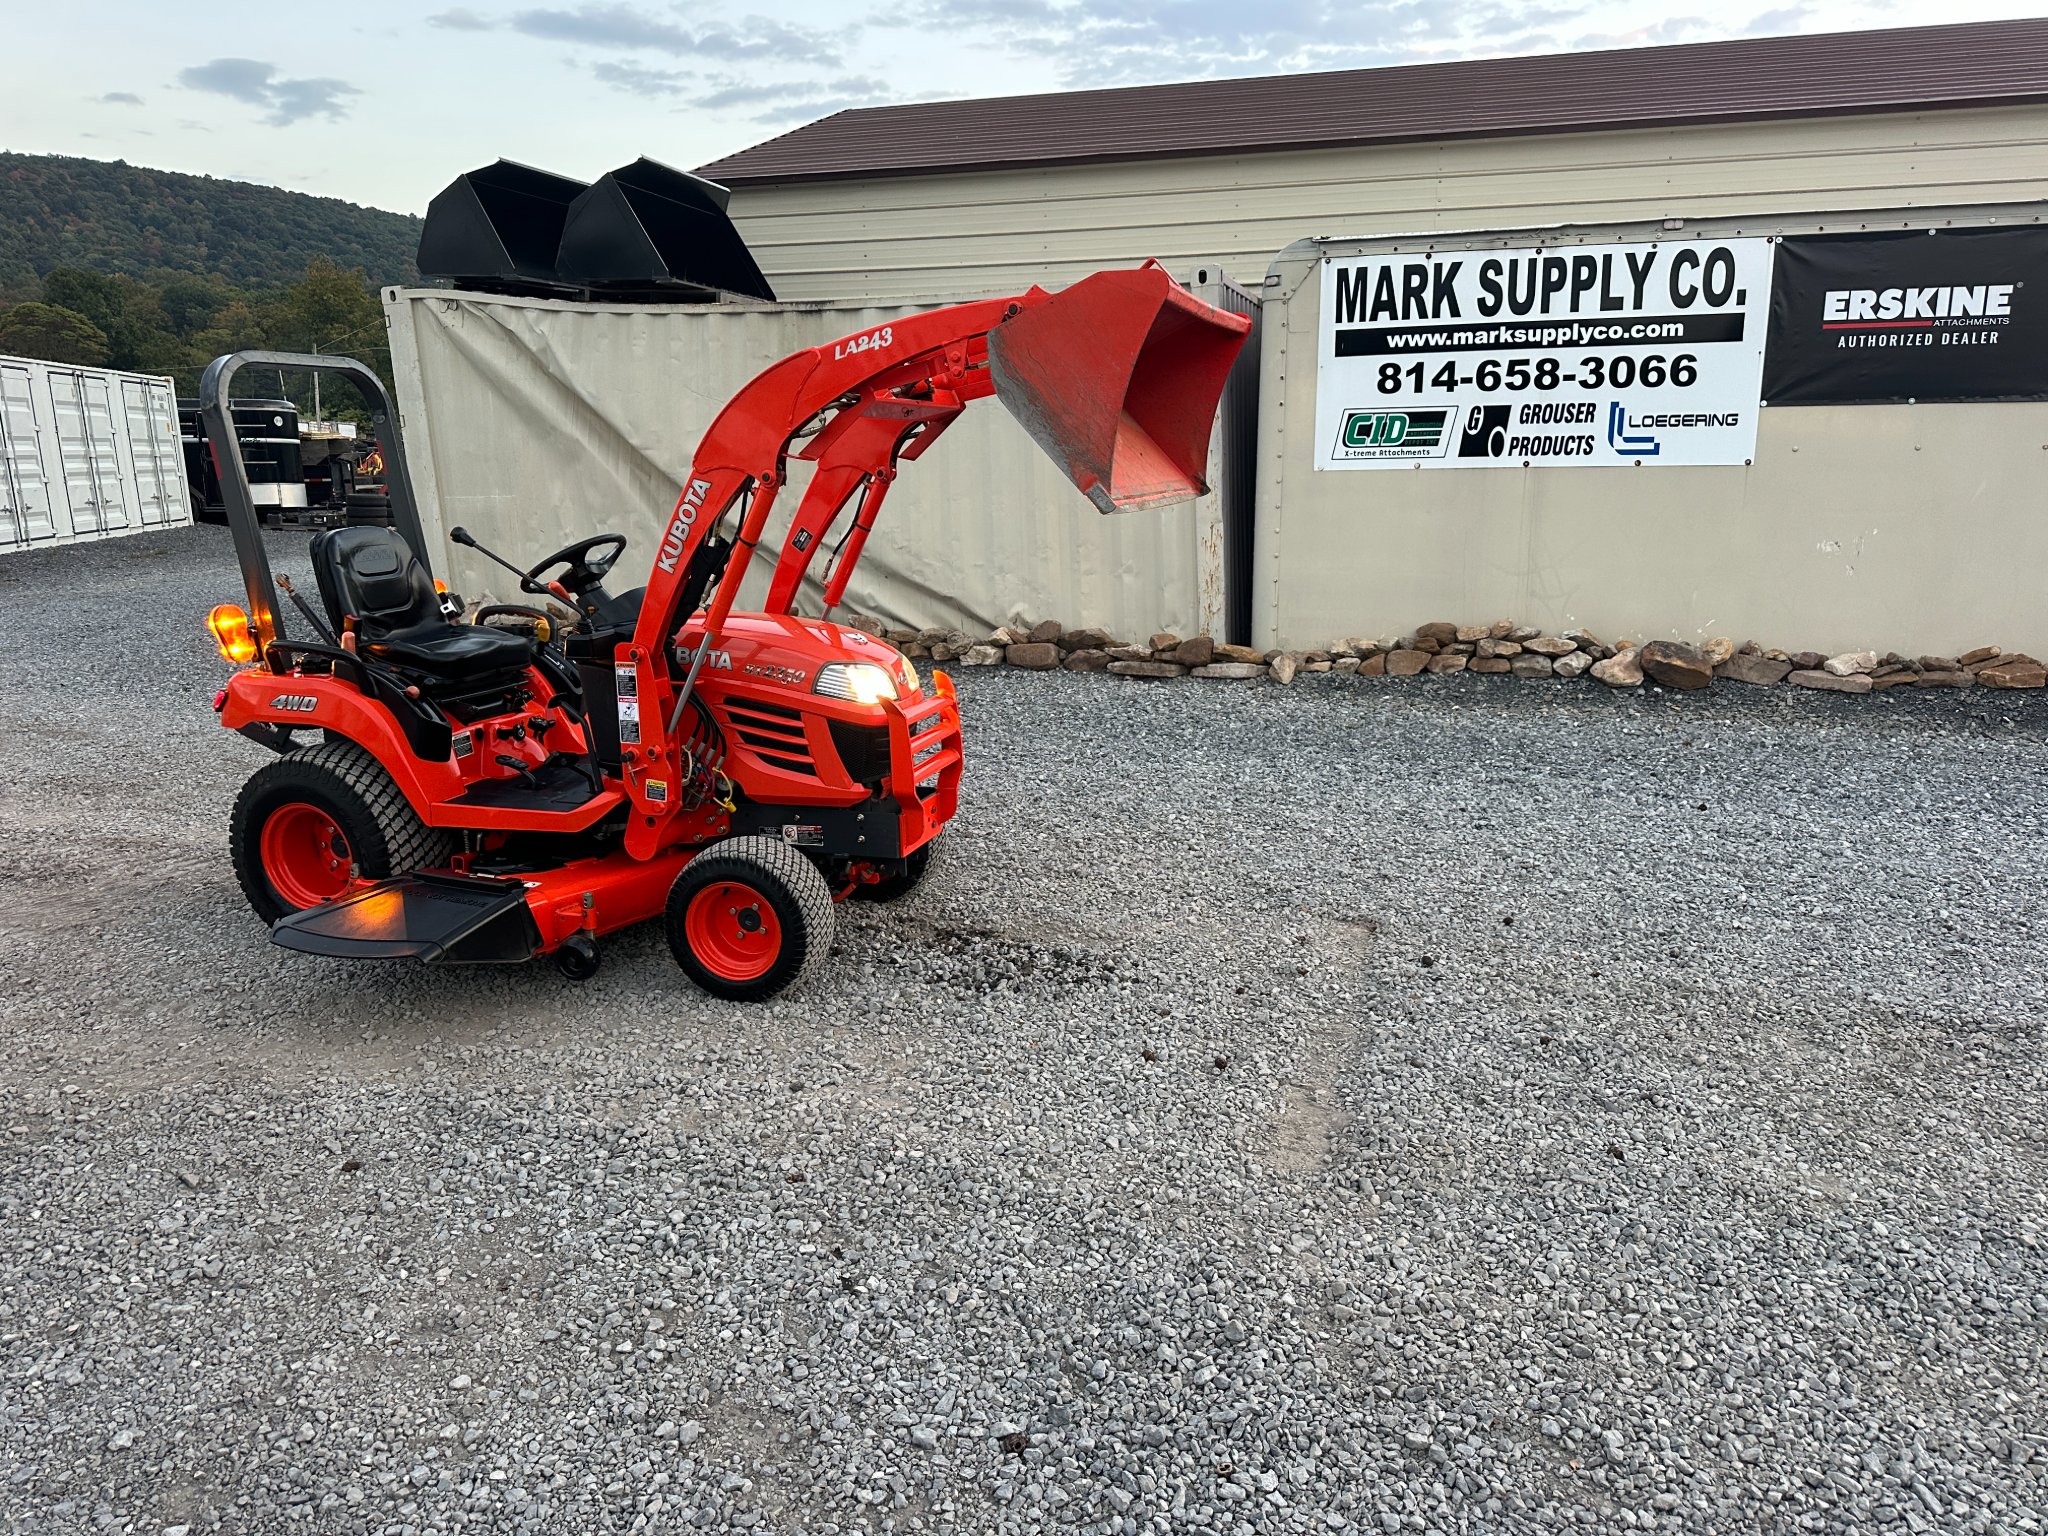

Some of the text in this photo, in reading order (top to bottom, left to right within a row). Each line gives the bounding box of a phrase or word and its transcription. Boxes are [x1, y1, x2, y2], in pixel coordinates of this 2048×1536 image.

[1335, 246, 1747, 324] MARK SUPPLY CO.
[1822, 284, 2014, 321] ERSKINE
[1932, 317, 2011, 327] ATTACHMENTS
[834, 326, 893, 361] LA243
[1386, 321, 1685, 349] www.marksupplyco.com
[1838, 331, 1999, 348] AUTHORIZED DEALER
[1376, 354, 1698, 395] 814-658-3066
[1519, 402, 1597, 425] GROUSER
[1628, 412, 1740, 429] LOEGERING
[1345, 412, 1409, 447] CID
[1344, 448, 1431, 457] X-treme Attachments
[1508, 434, 1596, 457] PRODUCTS
[656, 478, 713, 575] KUBOTA
[269, 694, 318, 712] 4WD
